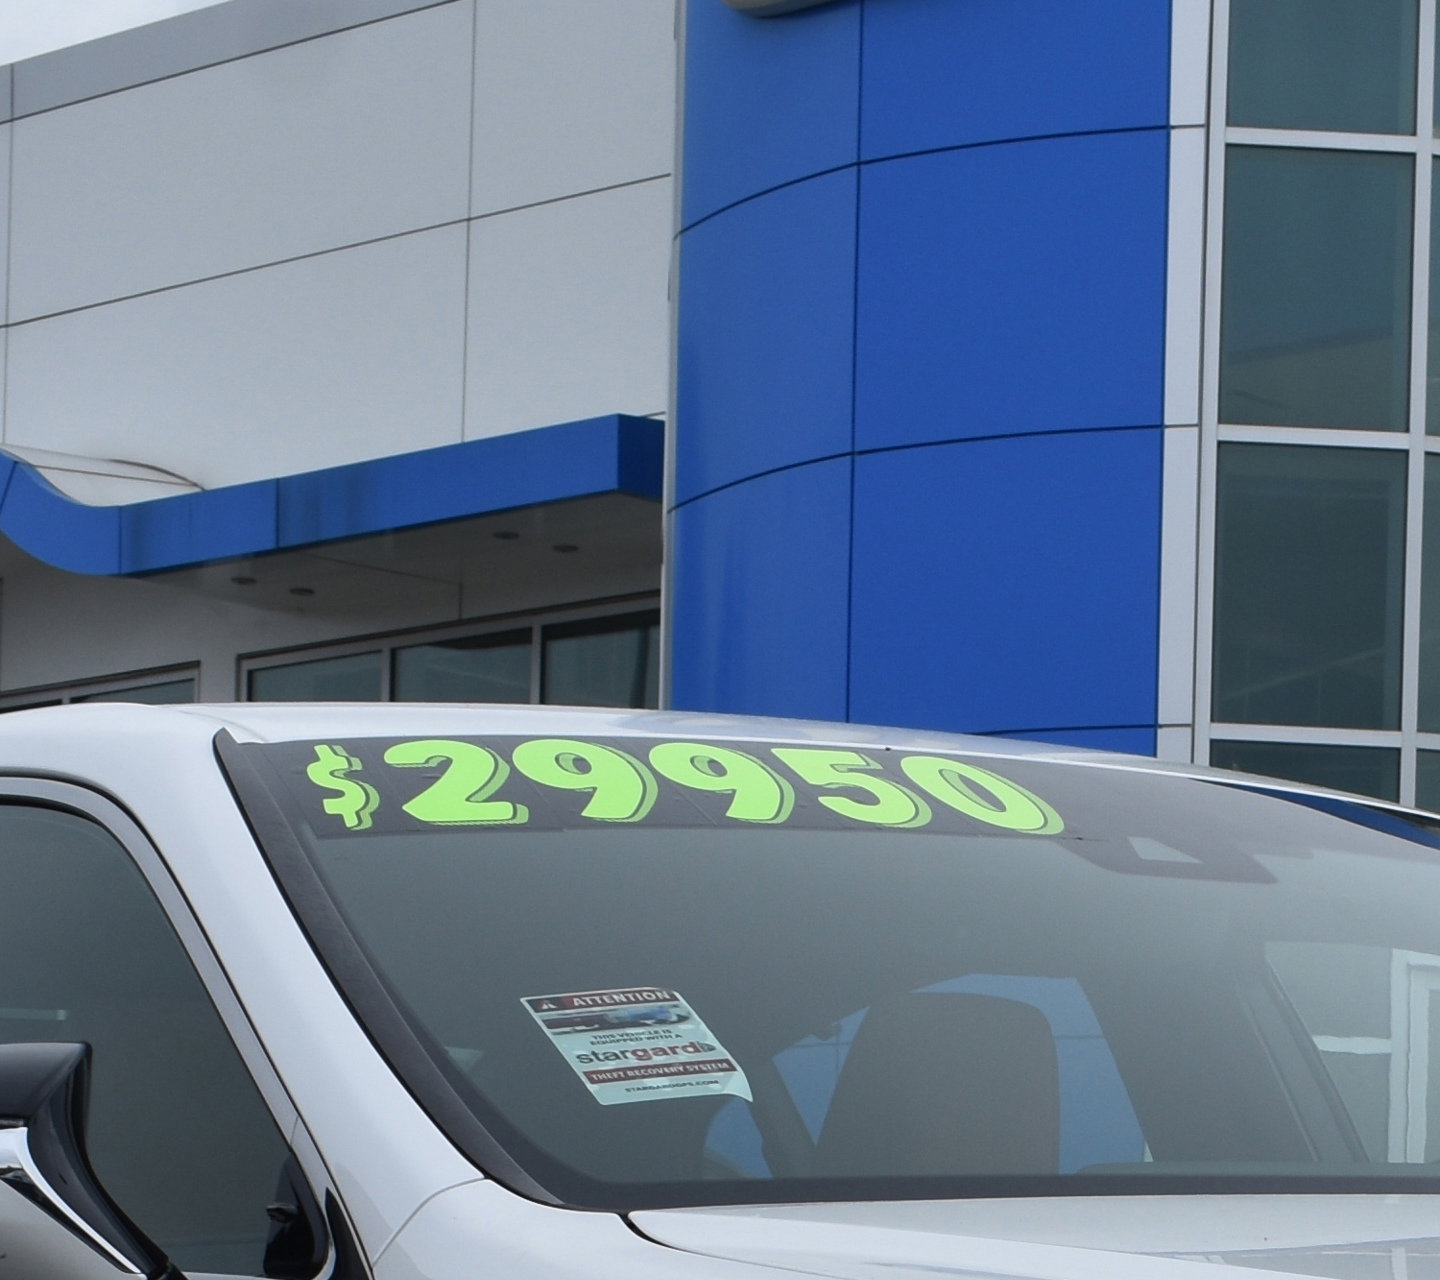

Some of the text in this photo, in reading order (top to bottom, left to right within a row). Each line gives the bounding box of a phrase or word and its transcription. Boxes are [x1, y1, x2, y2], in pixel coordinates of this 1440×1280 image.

[305, 738, 1066, 836] $29950
[571, 989, 671, 1007] ATTENTION
[576, 1041, 702, 1065] stargard
[590, 1062, 730, 1082] THEFT RECOVERY SYSTEM
